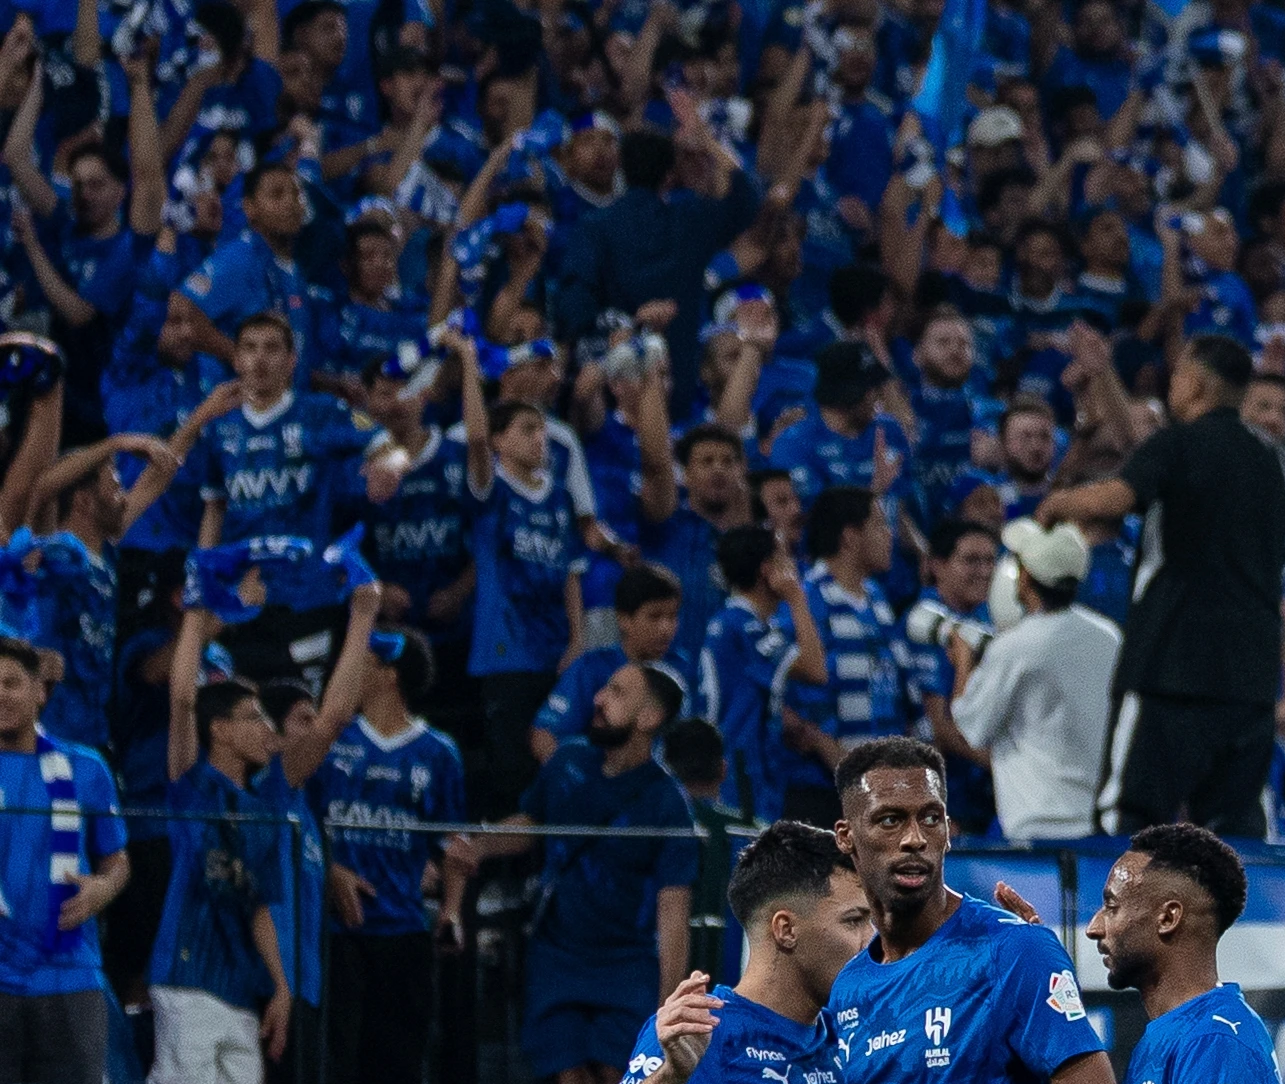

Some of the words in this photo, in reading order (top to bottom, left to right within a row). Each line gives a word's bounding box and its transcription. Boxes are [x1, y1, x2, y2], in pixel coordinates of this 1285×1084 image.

[745, 1046, 787, 1062] flynas
[865, 1029, 907, 1056] jahez
[629, 1053, 664, 1077] ee
